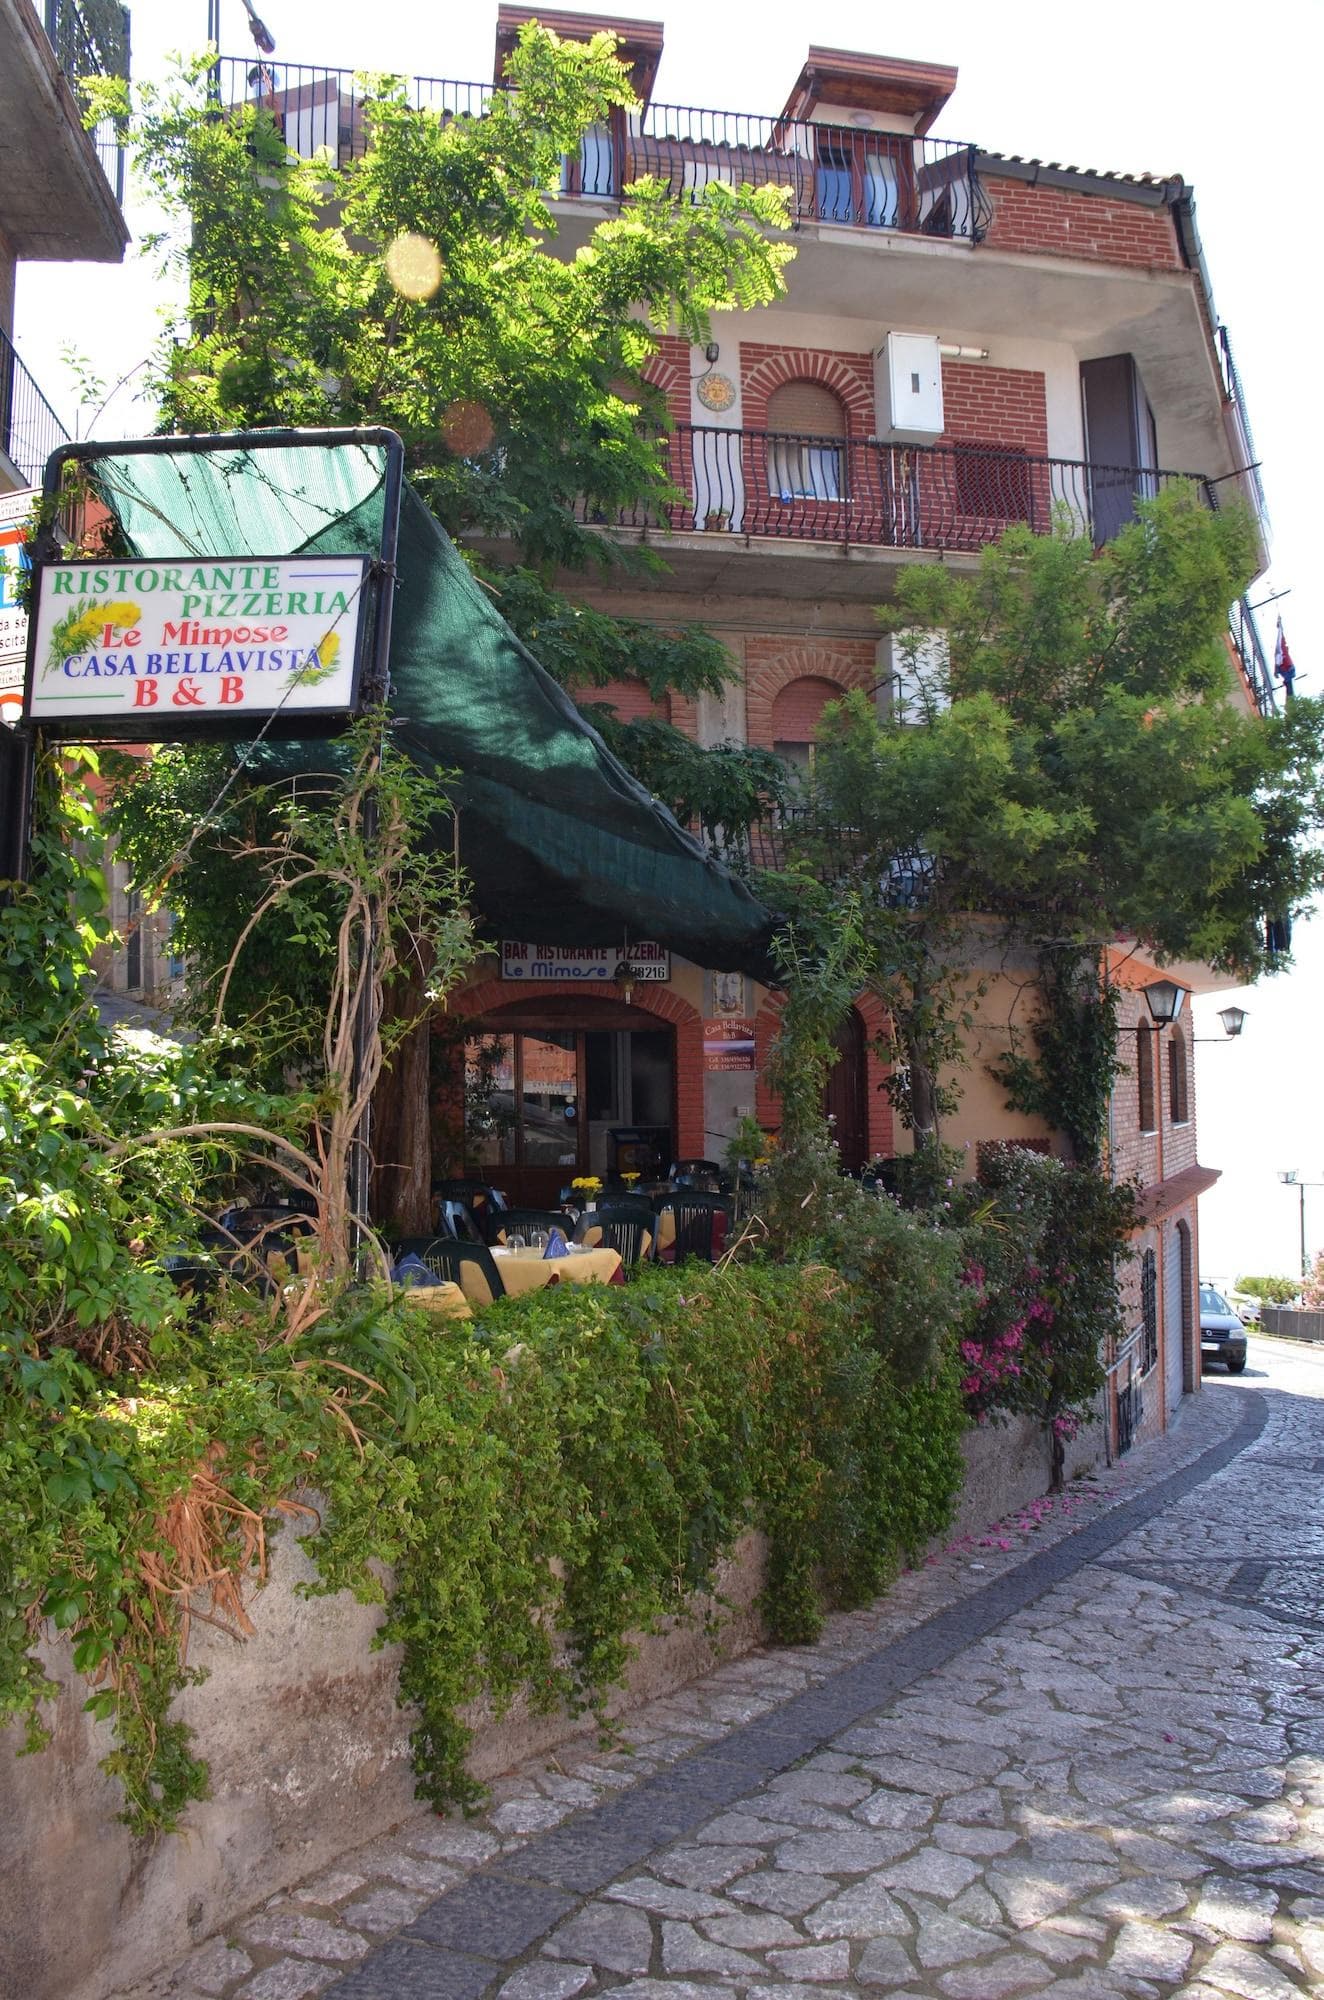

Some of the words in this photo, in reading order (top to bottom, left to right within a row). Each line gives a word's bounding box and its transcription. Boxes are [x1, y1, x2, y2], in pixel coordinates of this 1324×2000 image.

[53, 567, 279, 595] RISTORANTE
[181, 591, 351, 618] PIZZERIA
[102, 623, 142, 648] Le
[161, 620, 289, 650] Mimose
[63, 654, 137, 678] CASA
[145, 648, 322, 677] BELLAVISTA
[133, 679, 159, 707] B
[172, 677, 206, 706] &
[219, 676, 245, 705] B
[504, 942, 528, 960] BAR
[536, 943, 607, 961] RISTORANTE
[615, 943, 666, 961] PIZZERIA
[504, 962, 523, 977] Le
[531, 962, 607, 977] Mimose
